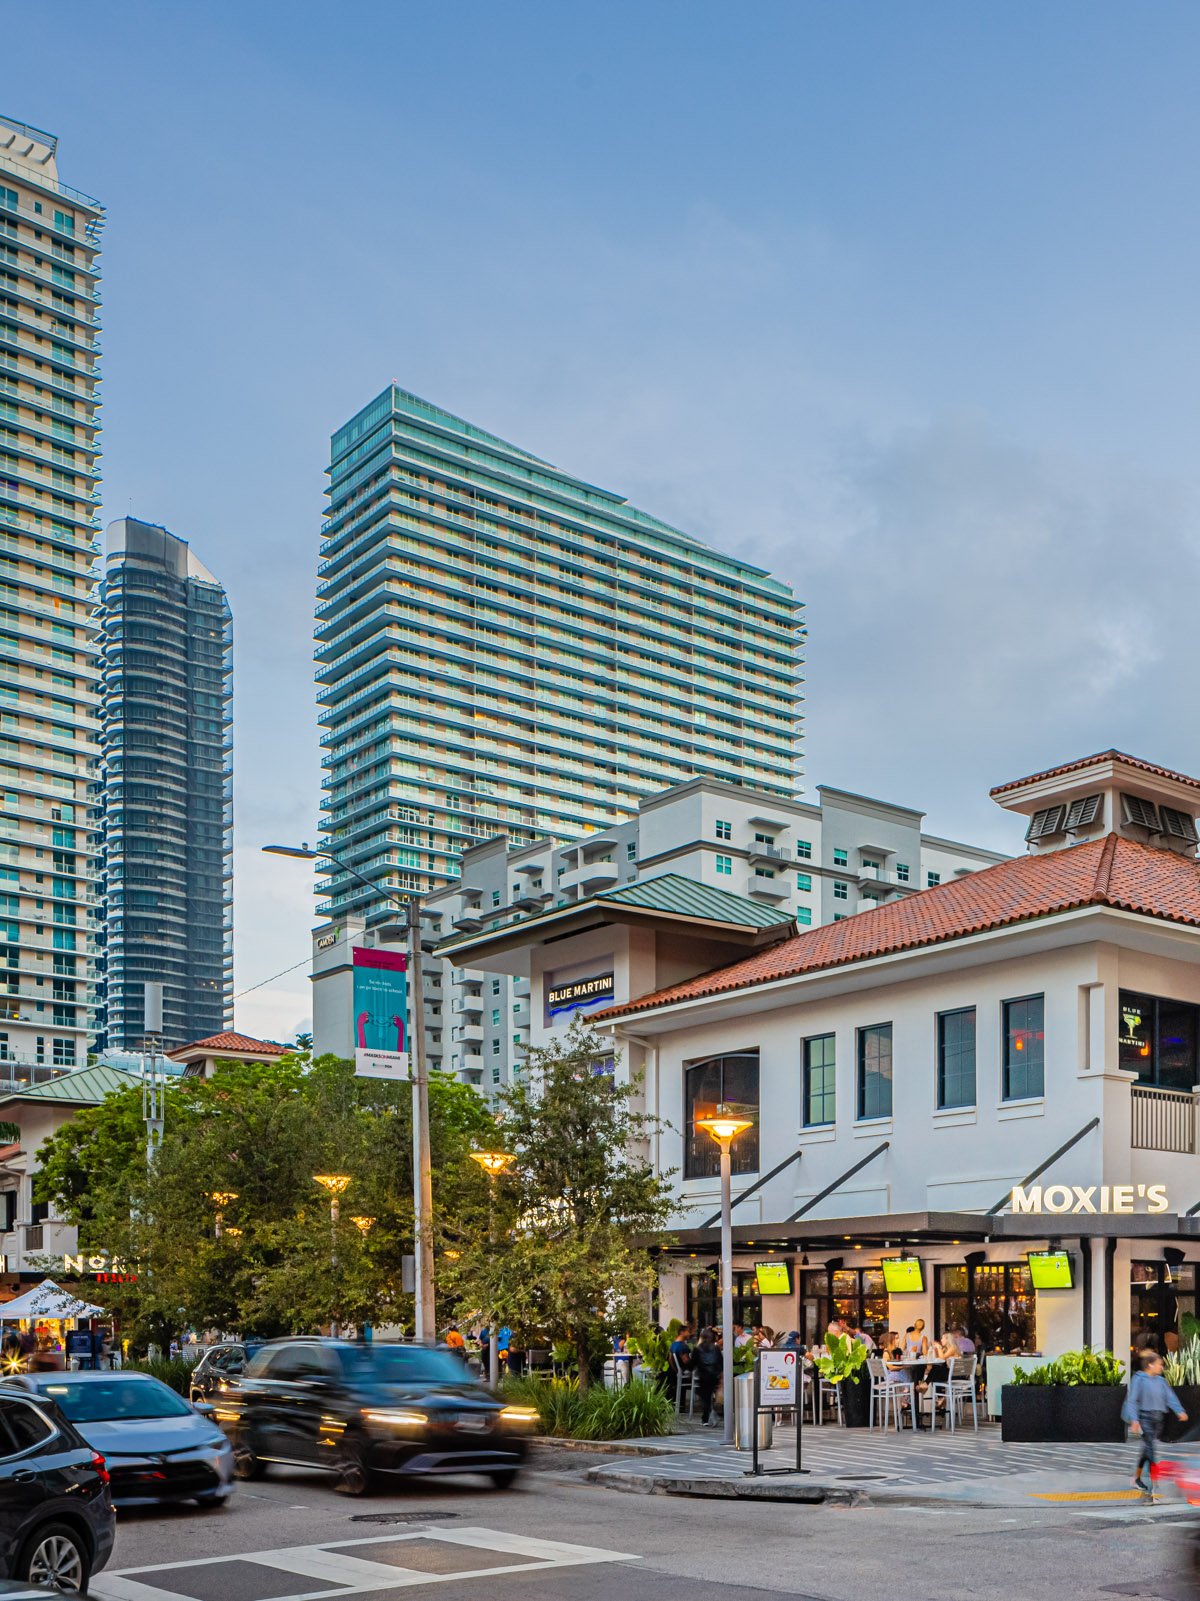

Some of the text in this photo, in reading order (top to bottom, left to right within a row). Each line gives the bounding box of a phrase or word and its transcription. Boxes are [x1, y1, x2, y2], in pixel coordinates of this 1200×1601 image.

[549, 977, 612, 1003] BLUE MARTINI
[1011, 1184, 1169, 1214] MOXIE'S
